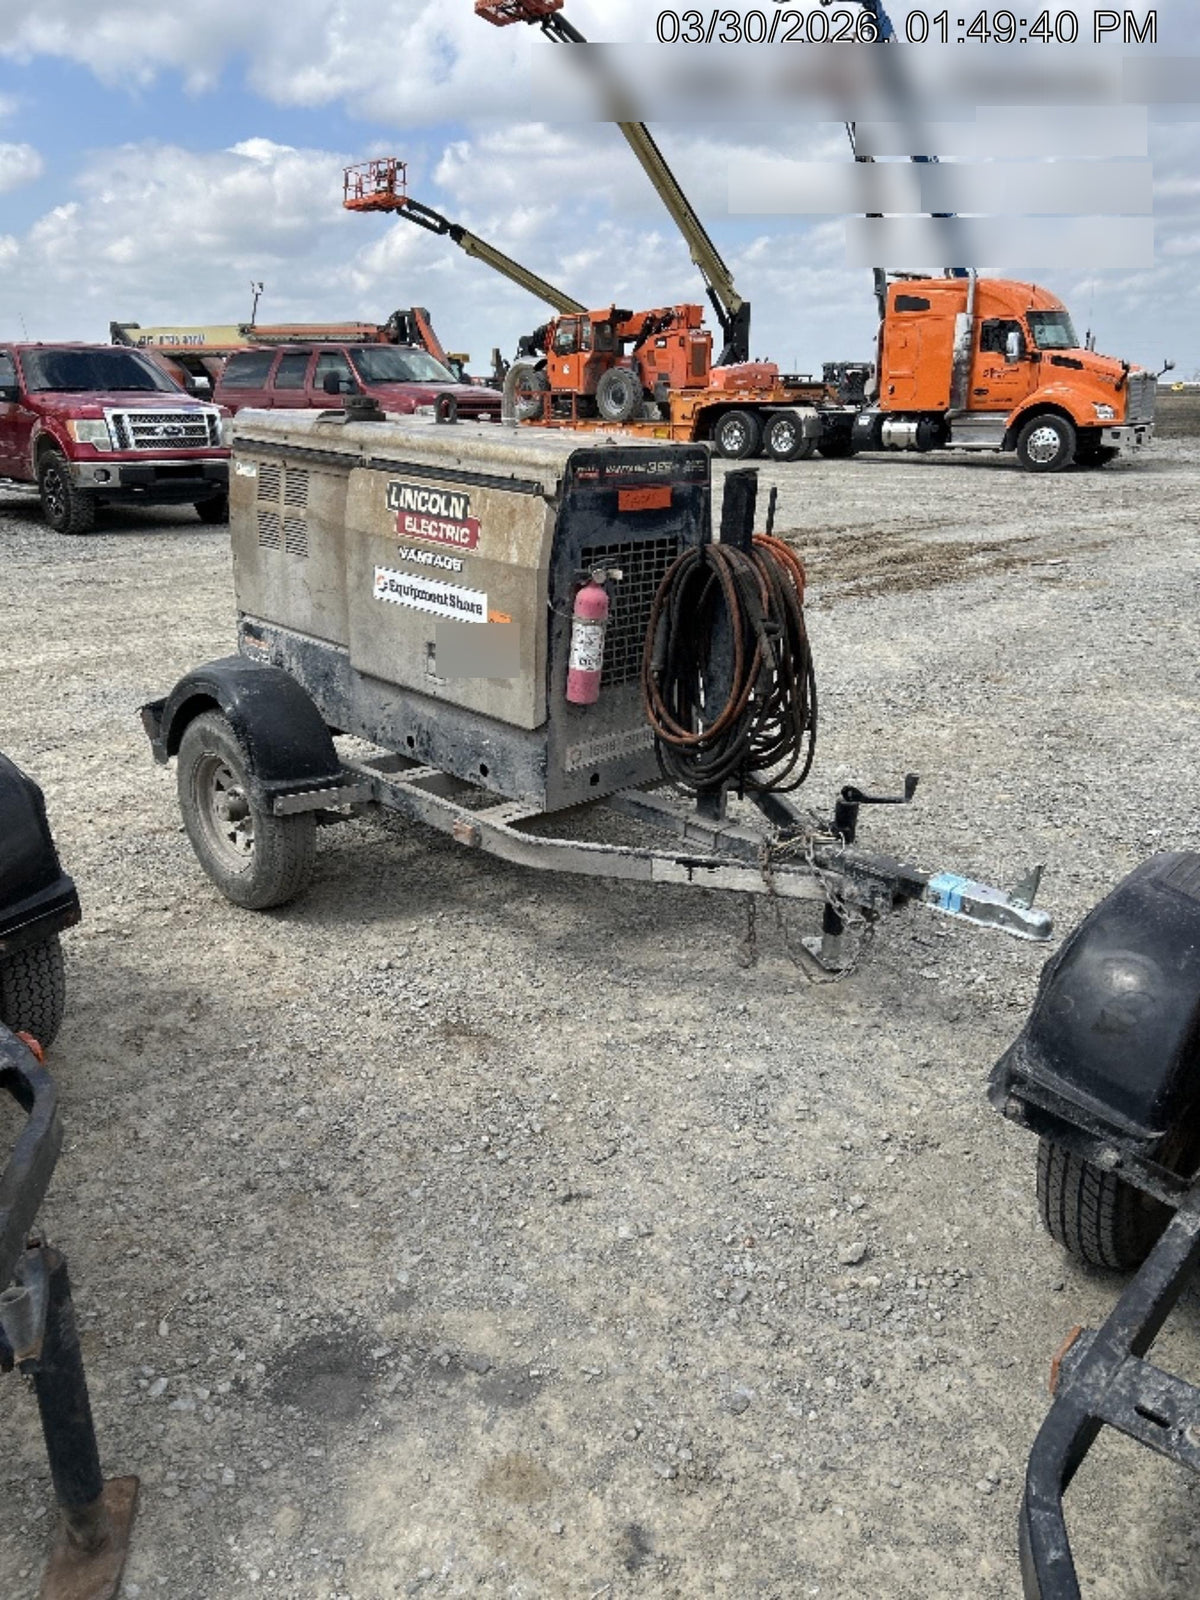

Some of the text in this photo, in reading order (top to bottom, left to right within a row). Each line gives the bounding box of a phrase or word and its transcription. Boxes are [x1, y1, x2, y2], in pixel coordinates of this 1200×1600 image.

[389, 485, 466, 520] LINCOLN
[404, 516, 471, 544] ELECTRIC
[398, 545, 464, 572] VANTAGE
[388, 579, 483, 615] EquipmentShare
